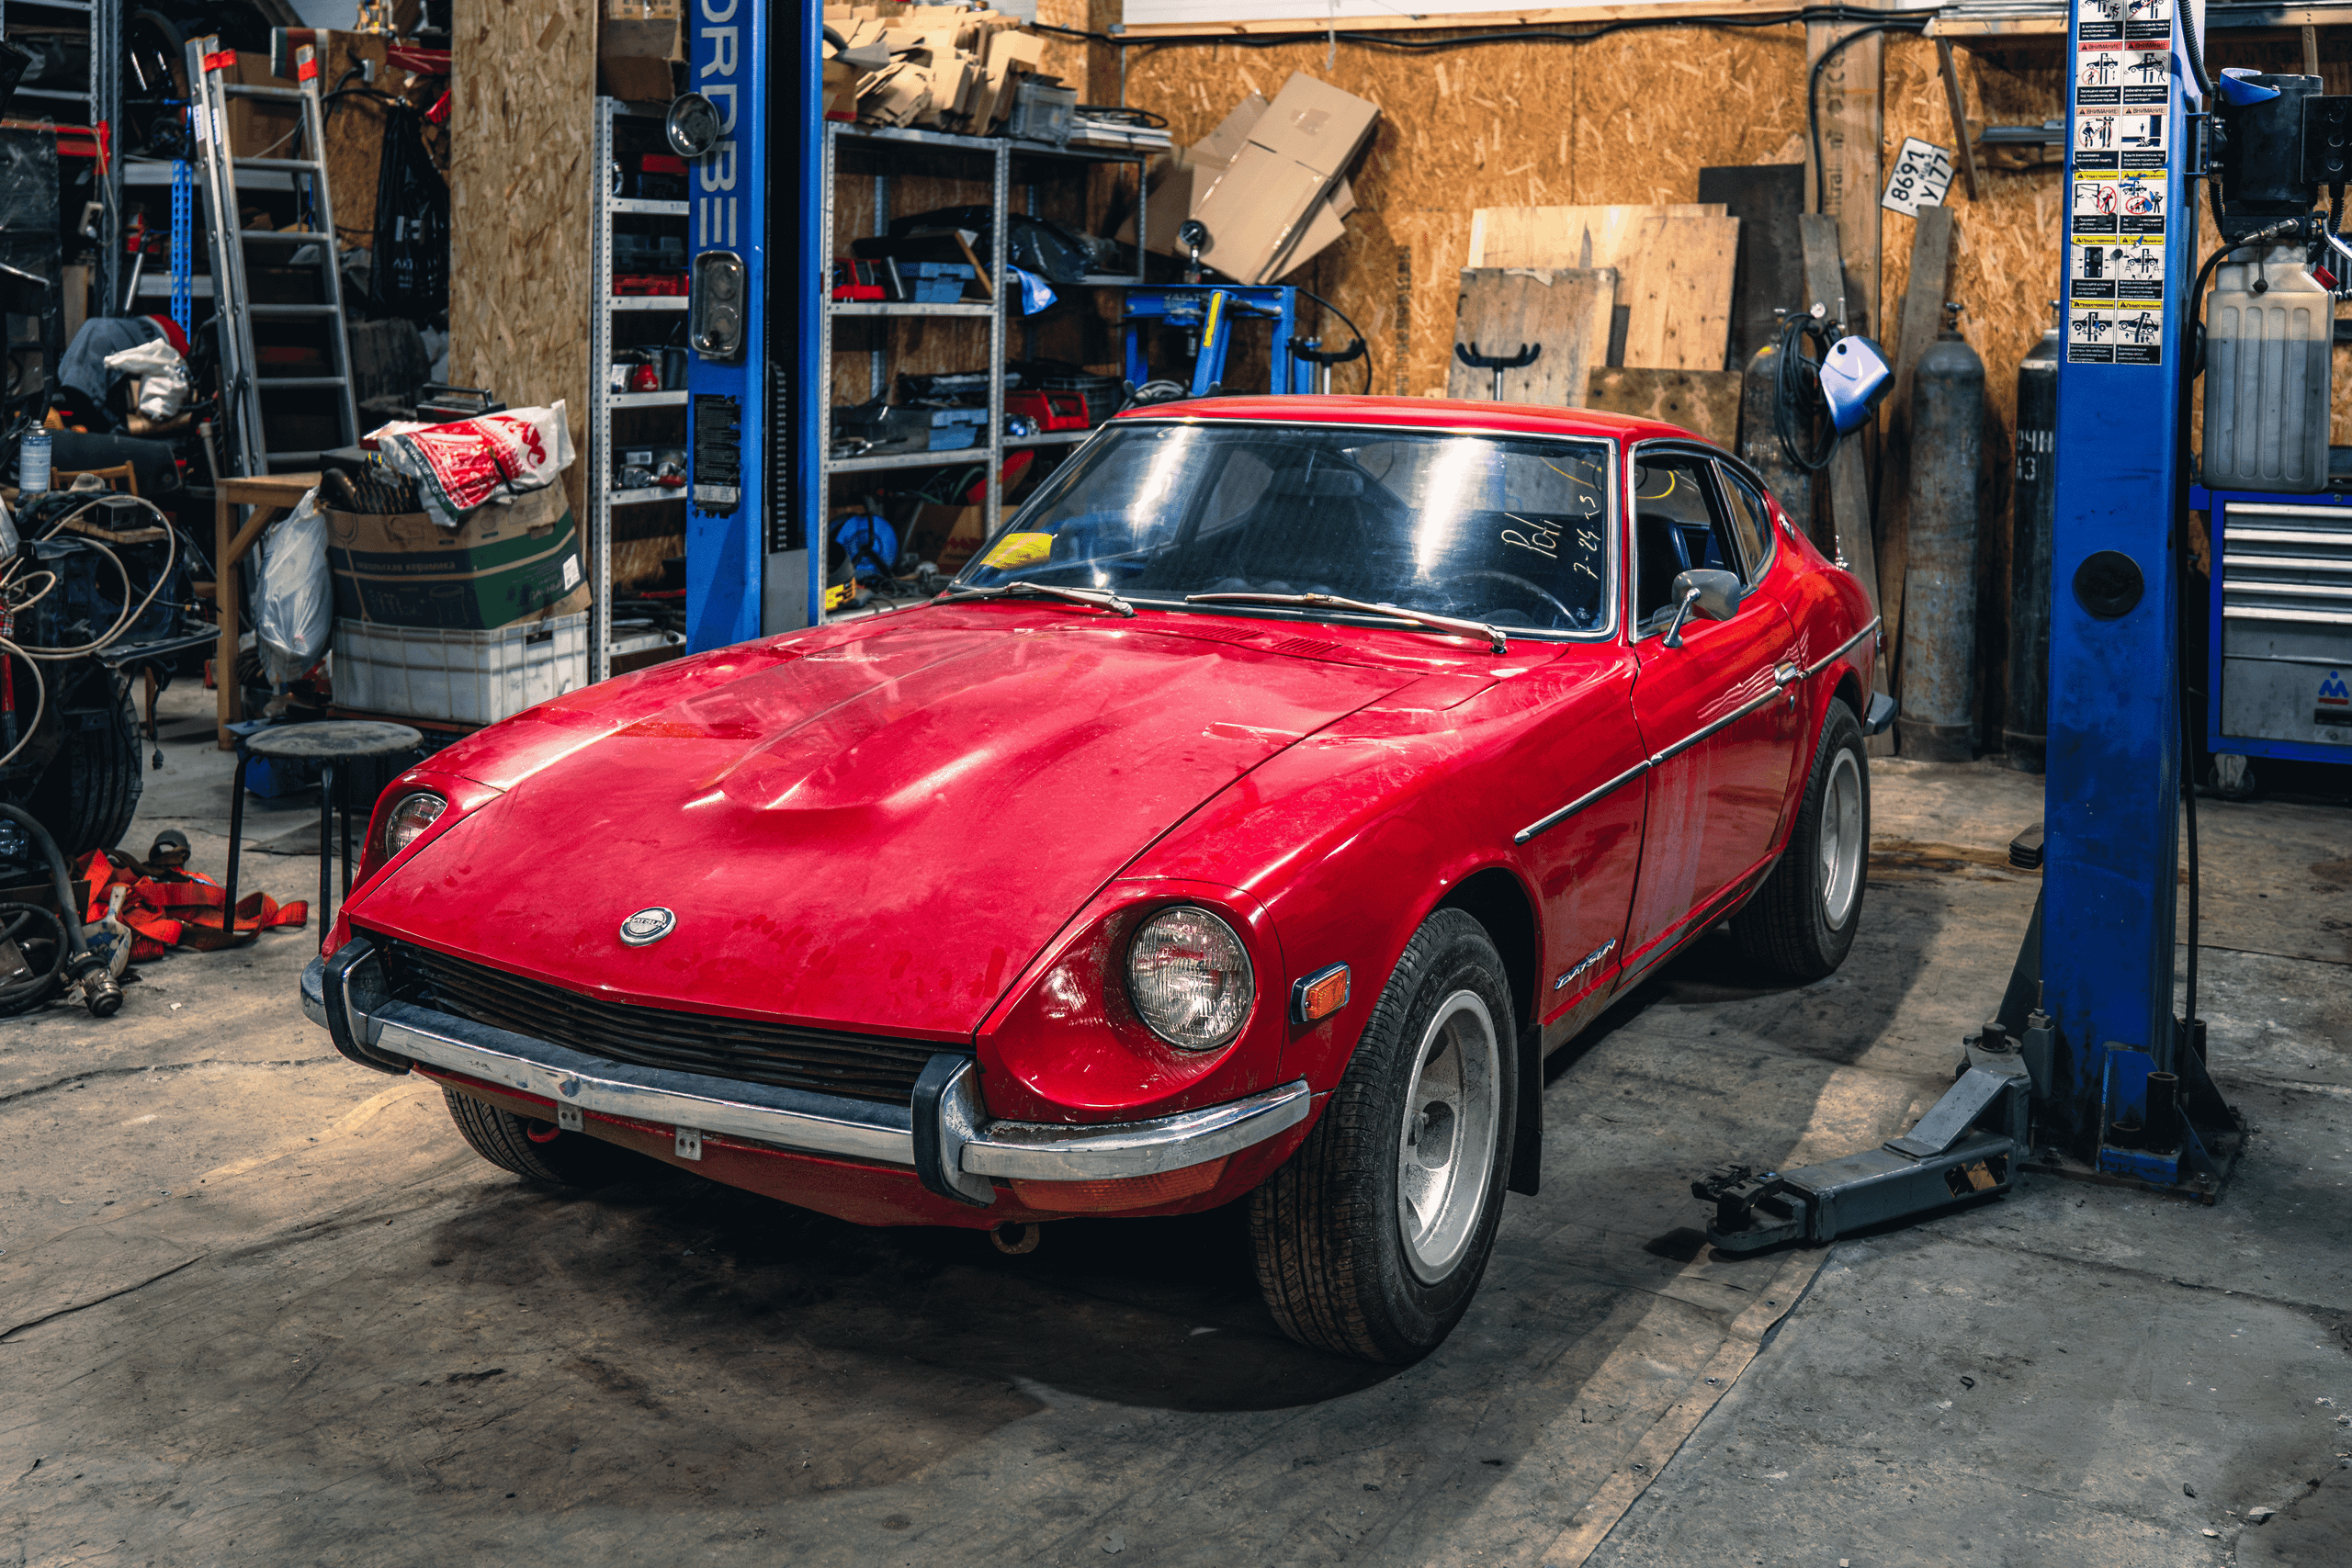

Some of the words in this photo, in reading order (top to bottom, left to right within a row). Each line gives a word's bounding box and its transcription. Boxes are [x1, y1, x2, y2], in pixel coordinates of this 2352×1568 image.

[2088, 42, 2121, 51] ВНИМАНИЕ!
[1891, 151, 1925, 201] 8691
[1928, 154, 1949, 179] 77
[628, 918, 668, 928] DATSUN
[1554, 937, 1616, 990] DATSUN
